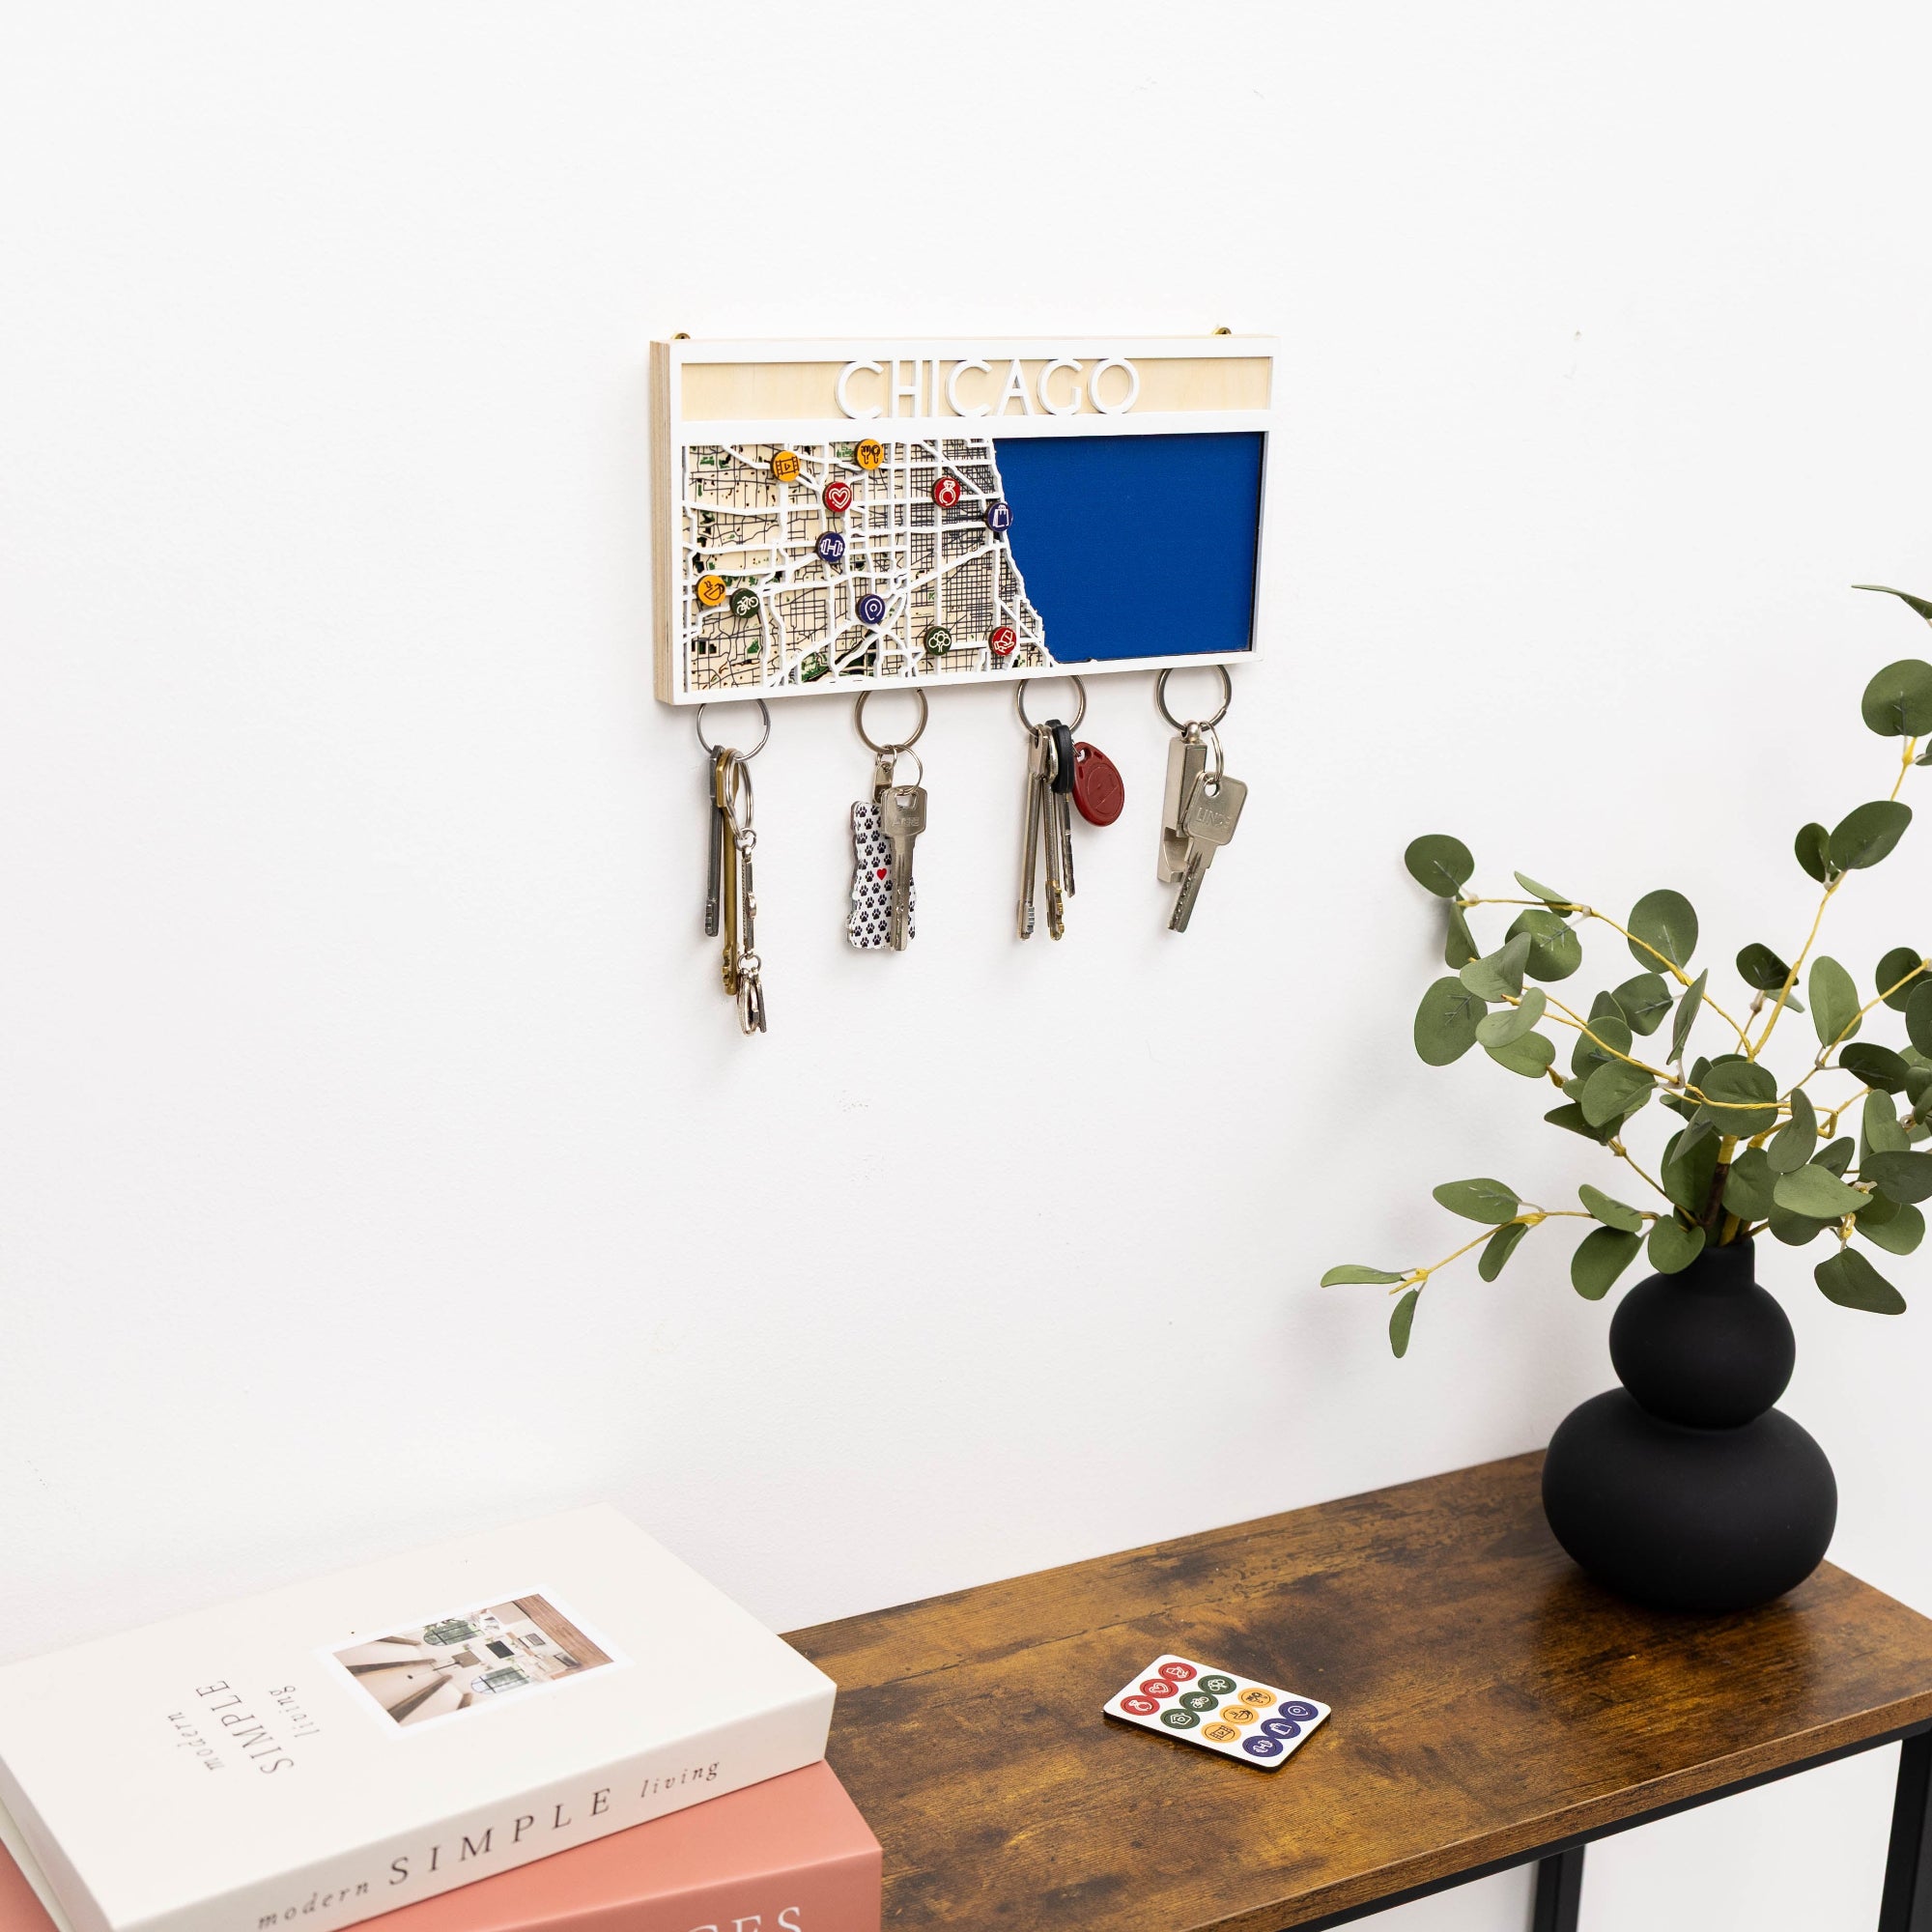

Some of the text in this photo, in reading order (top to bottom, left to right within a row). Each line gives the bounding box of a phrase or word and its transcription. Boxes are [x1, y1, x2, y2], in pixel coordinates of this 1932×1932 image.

[835, 357, 1140, 419] CHICAGO
[167, 1711, 225, 1771] modern
[195, 1680, 295, 1775] SIMPLE
[270, 1685, 321, 1738] living
[256, 1759, 722, 1930] modern SIMPLE living
